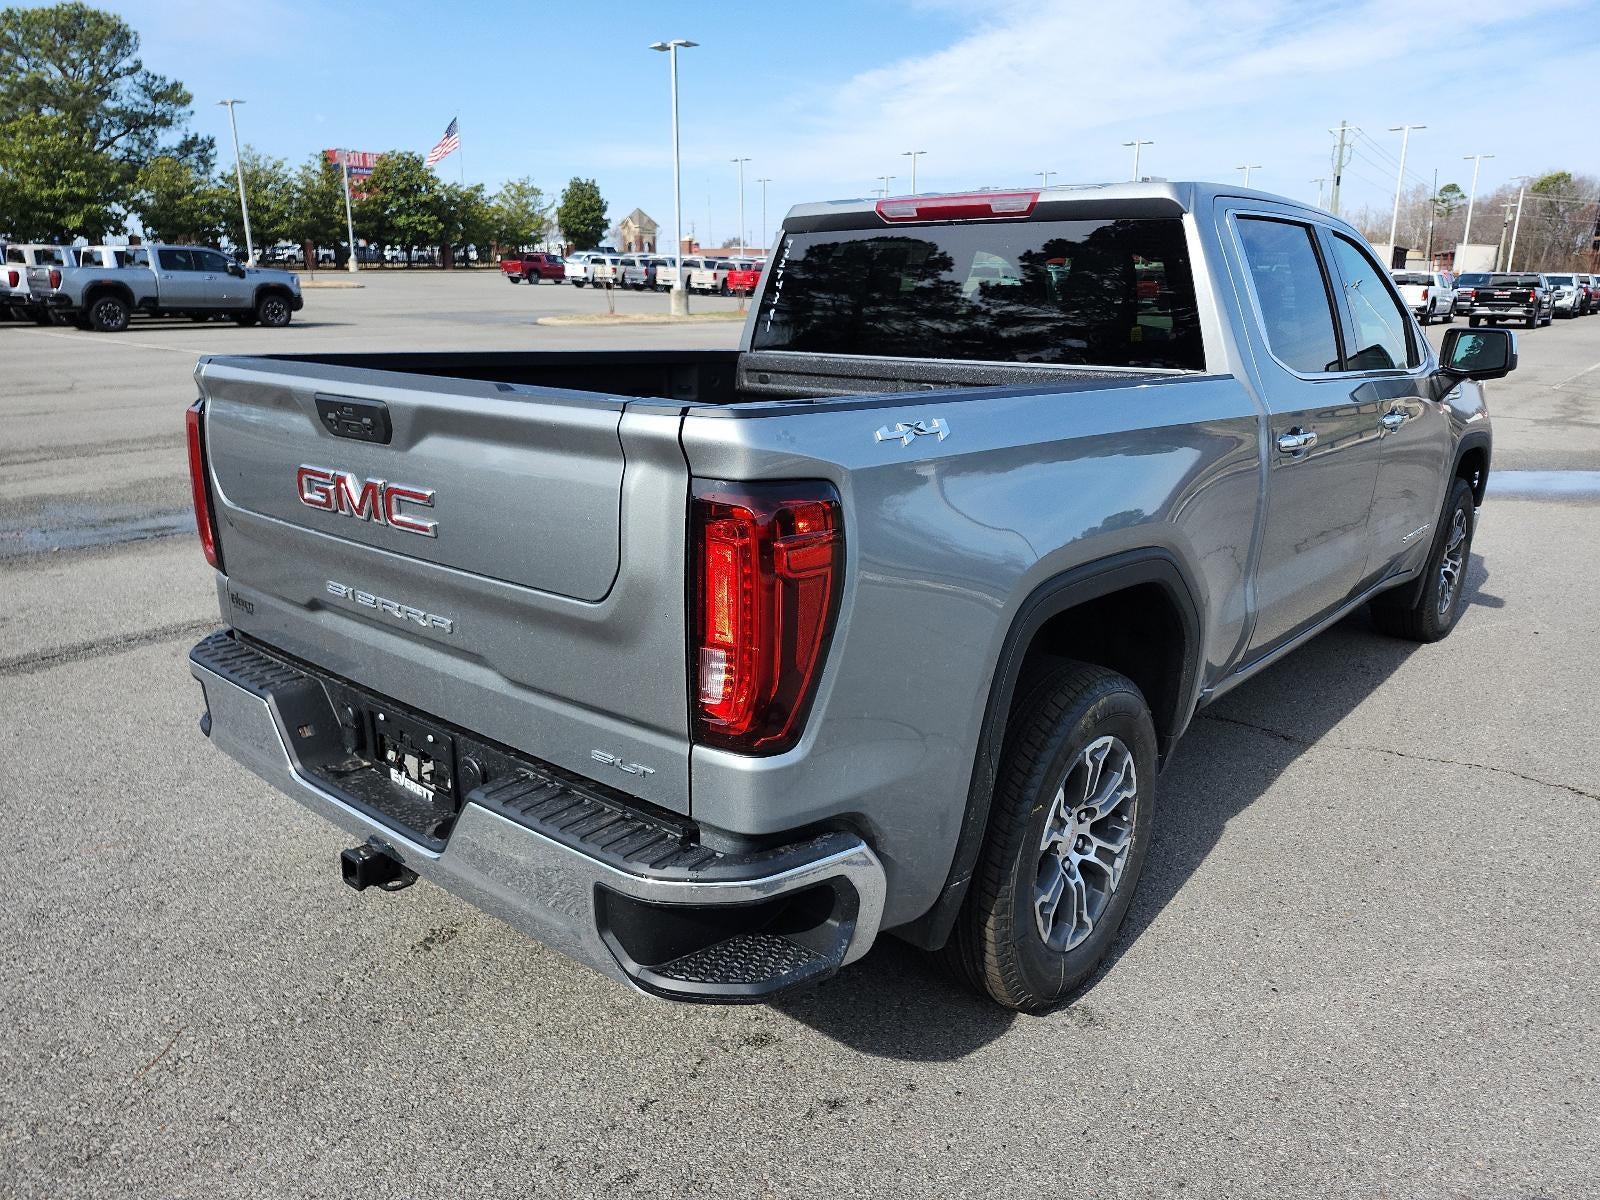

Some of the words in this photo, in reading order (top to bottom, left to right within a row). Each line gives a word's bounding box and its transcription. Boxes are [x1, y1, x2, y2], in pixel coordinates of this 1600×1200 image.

[297, 463, 439, 538] GMC
[326, 580, 454, 635] SIERRA
[591, 749, 656, 777] SLT
